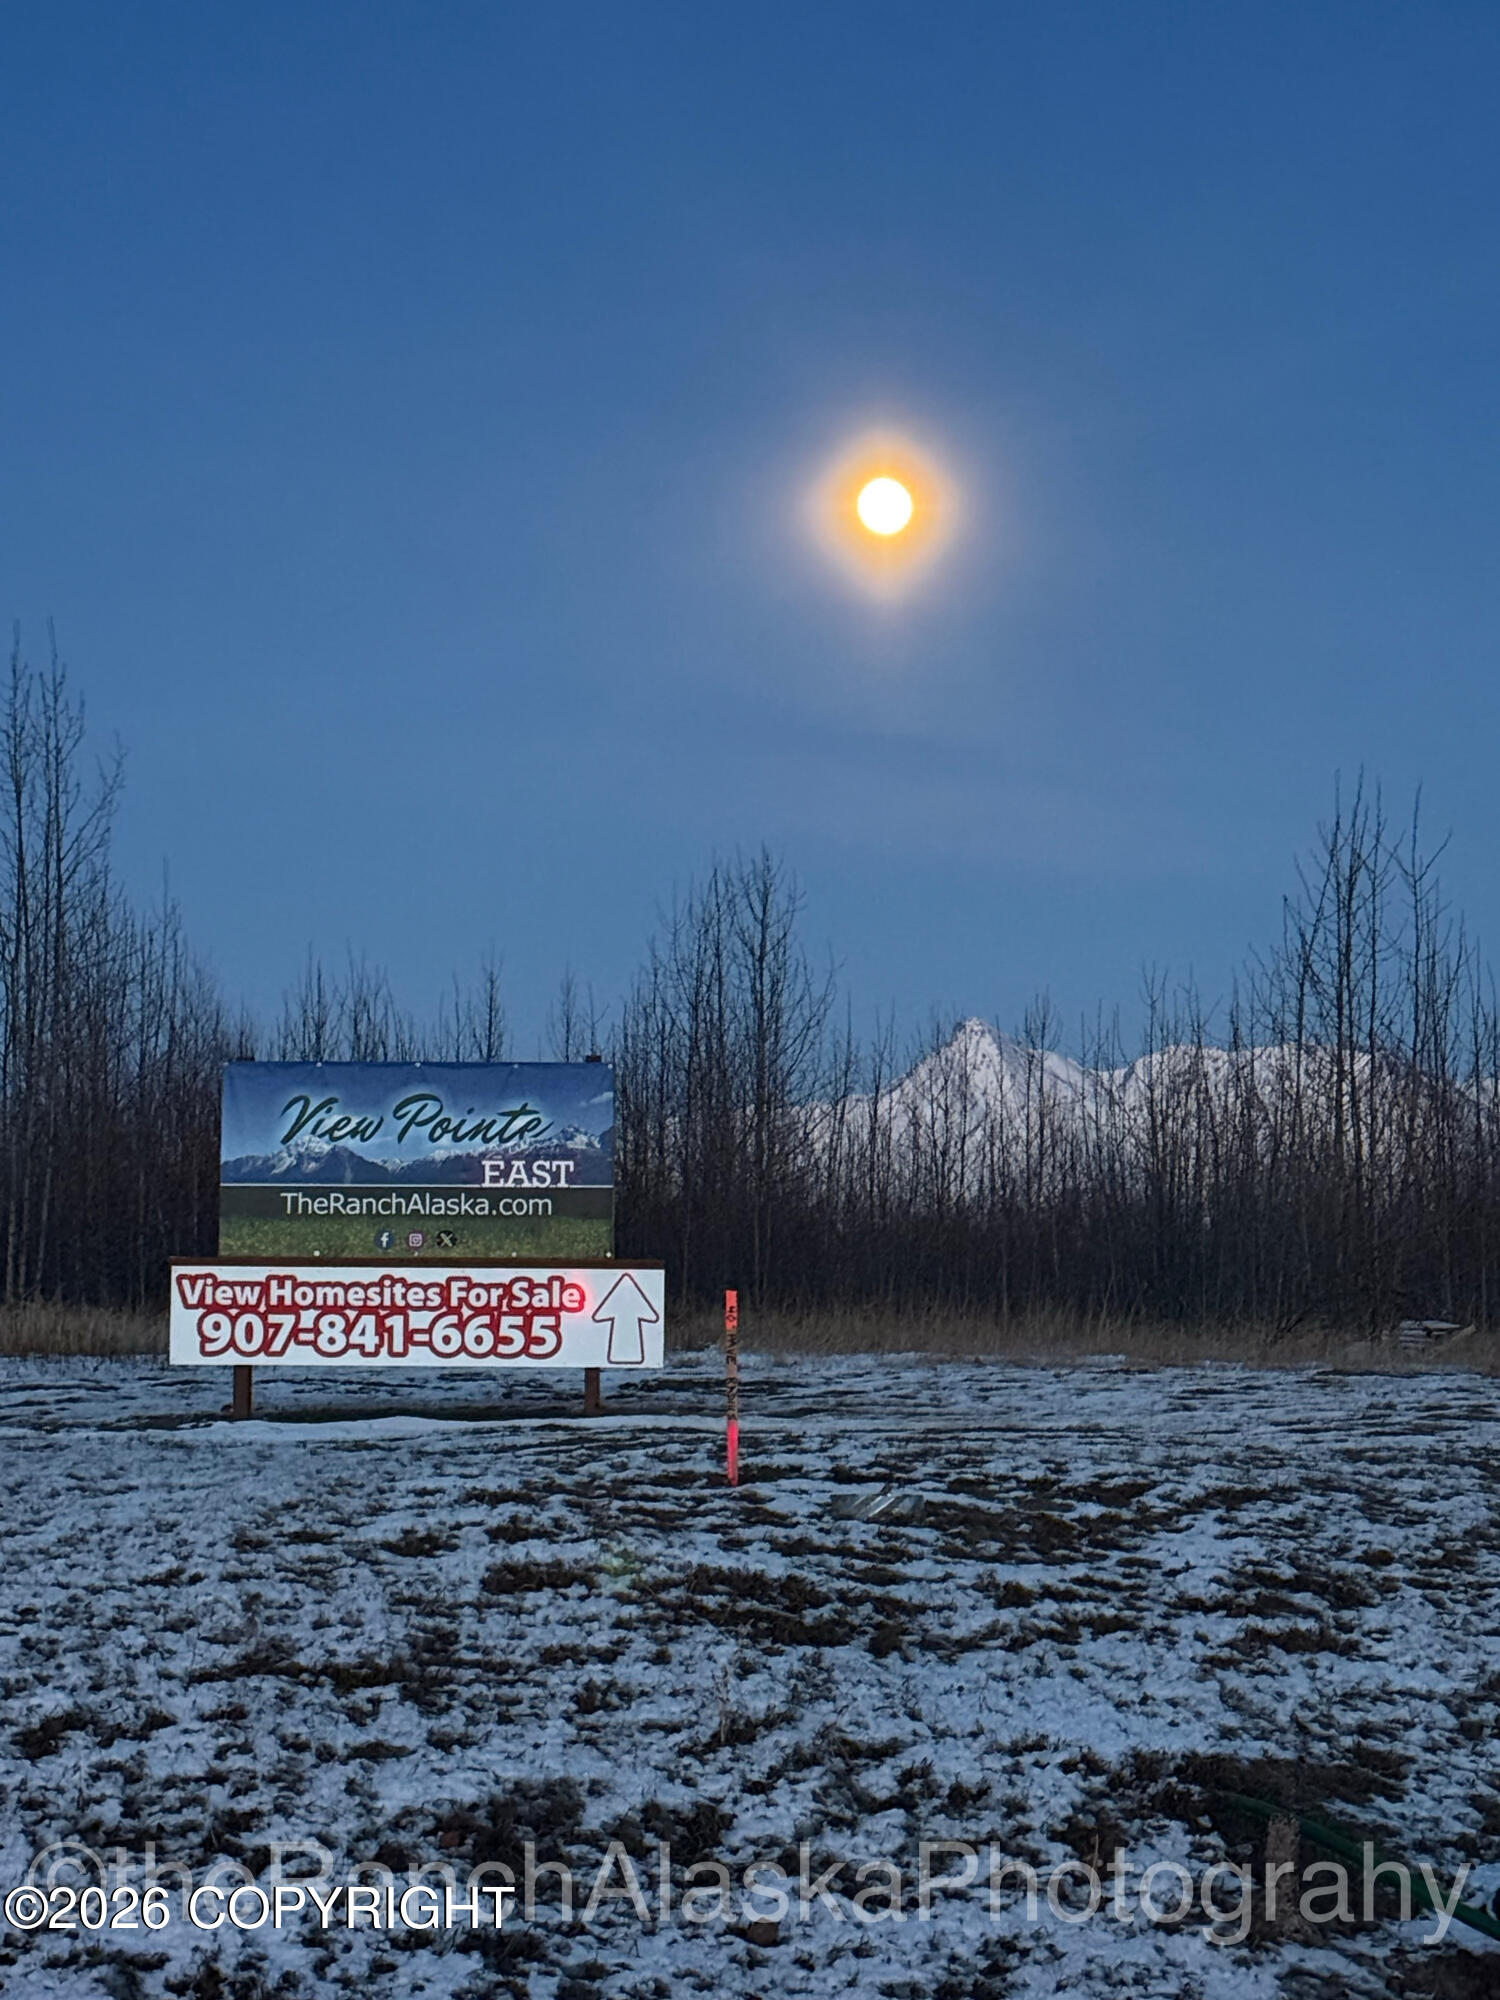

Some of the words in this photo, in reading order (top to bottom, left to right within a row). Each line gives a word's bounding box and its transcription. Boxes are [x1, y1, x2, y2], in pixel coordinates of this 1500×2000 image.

[280, 1094, 384, 1145] View
[392, 1093, 554, 1144] Pointe
[480, 1160, 575, 1188] EAST
[280, 1192, 553, 1216] TheRanchAlaska.com
[180, 1278, 261, 1308] View
[269, 1278, 442, 1309] Homesites
[449, 1279, 505, 1309] For
[510, 1280, 582, 1309] Sale
[201, 1312, 560, 1356] 907-841-6655
